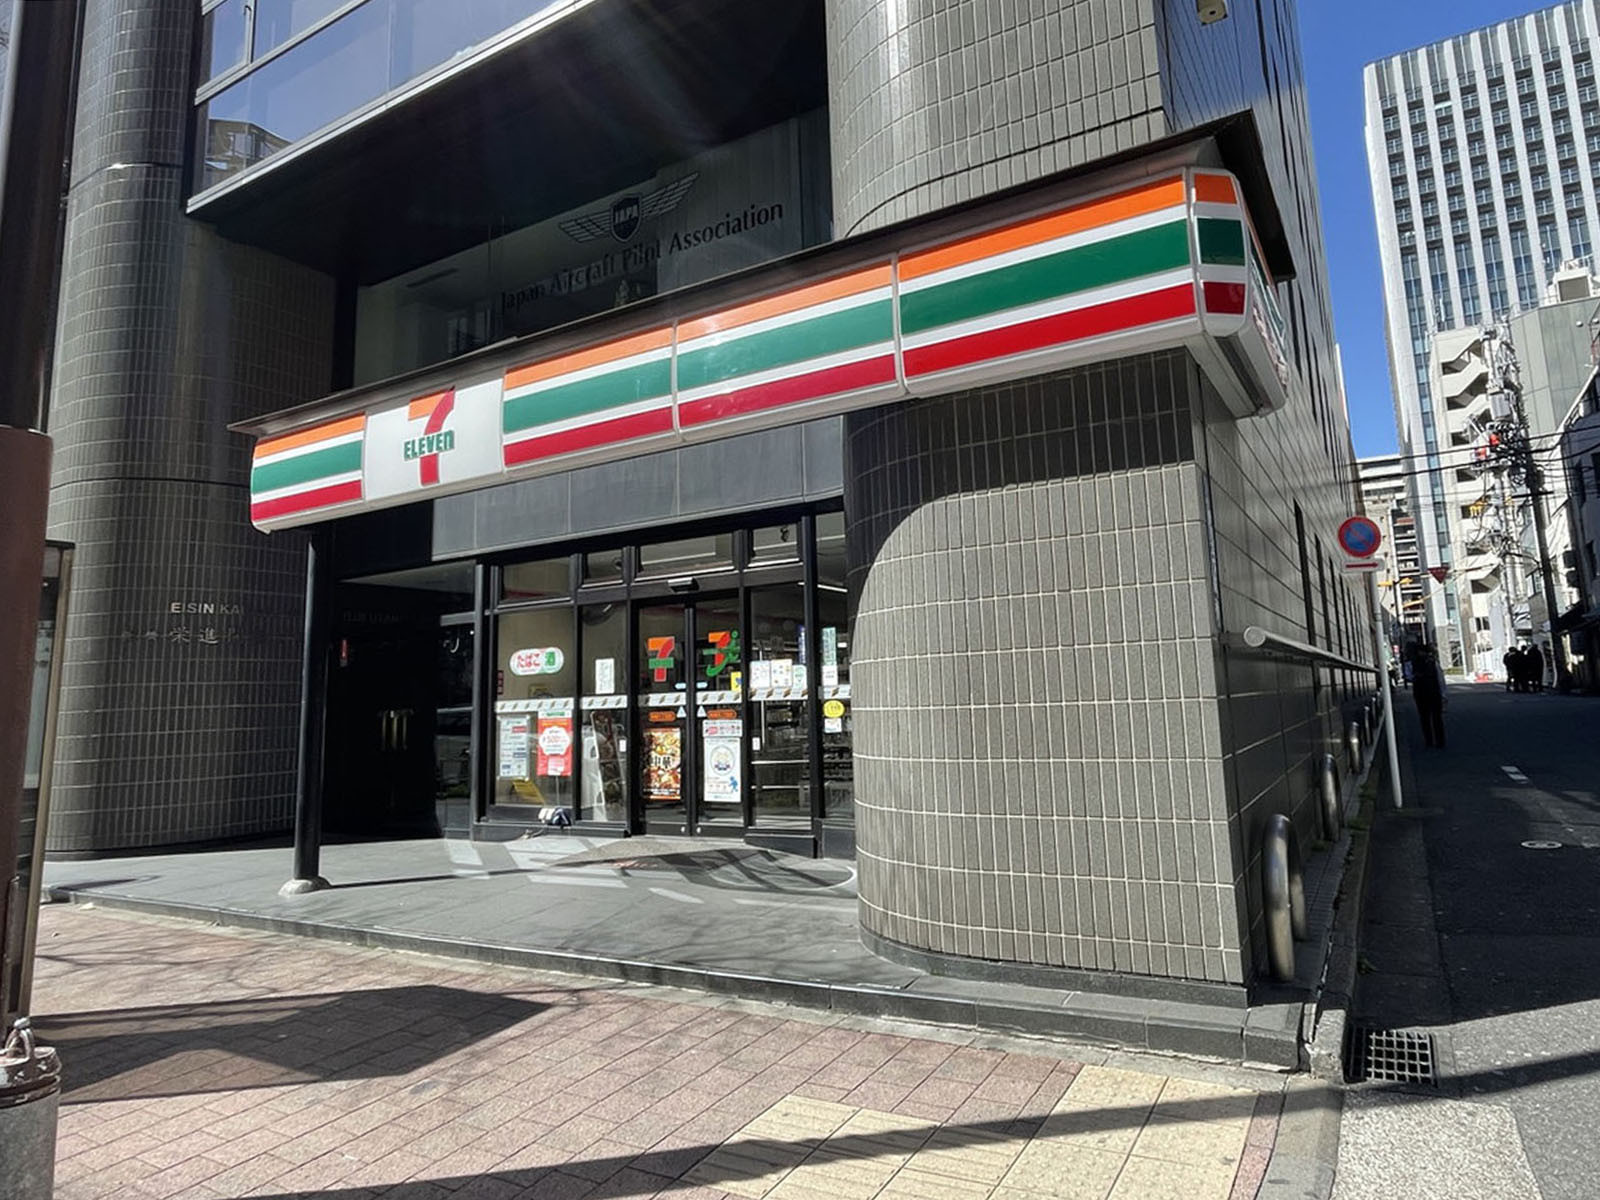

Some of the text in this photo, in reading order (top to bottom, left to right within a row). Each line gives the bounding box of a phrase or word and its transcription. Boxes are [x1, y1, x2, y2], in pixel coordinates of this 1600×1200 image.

[502, 202, 784, 312] Japan Aircraft Pilot Association
[408, 386, 455, 487] 7
[648, 636, 675, 682] 7
